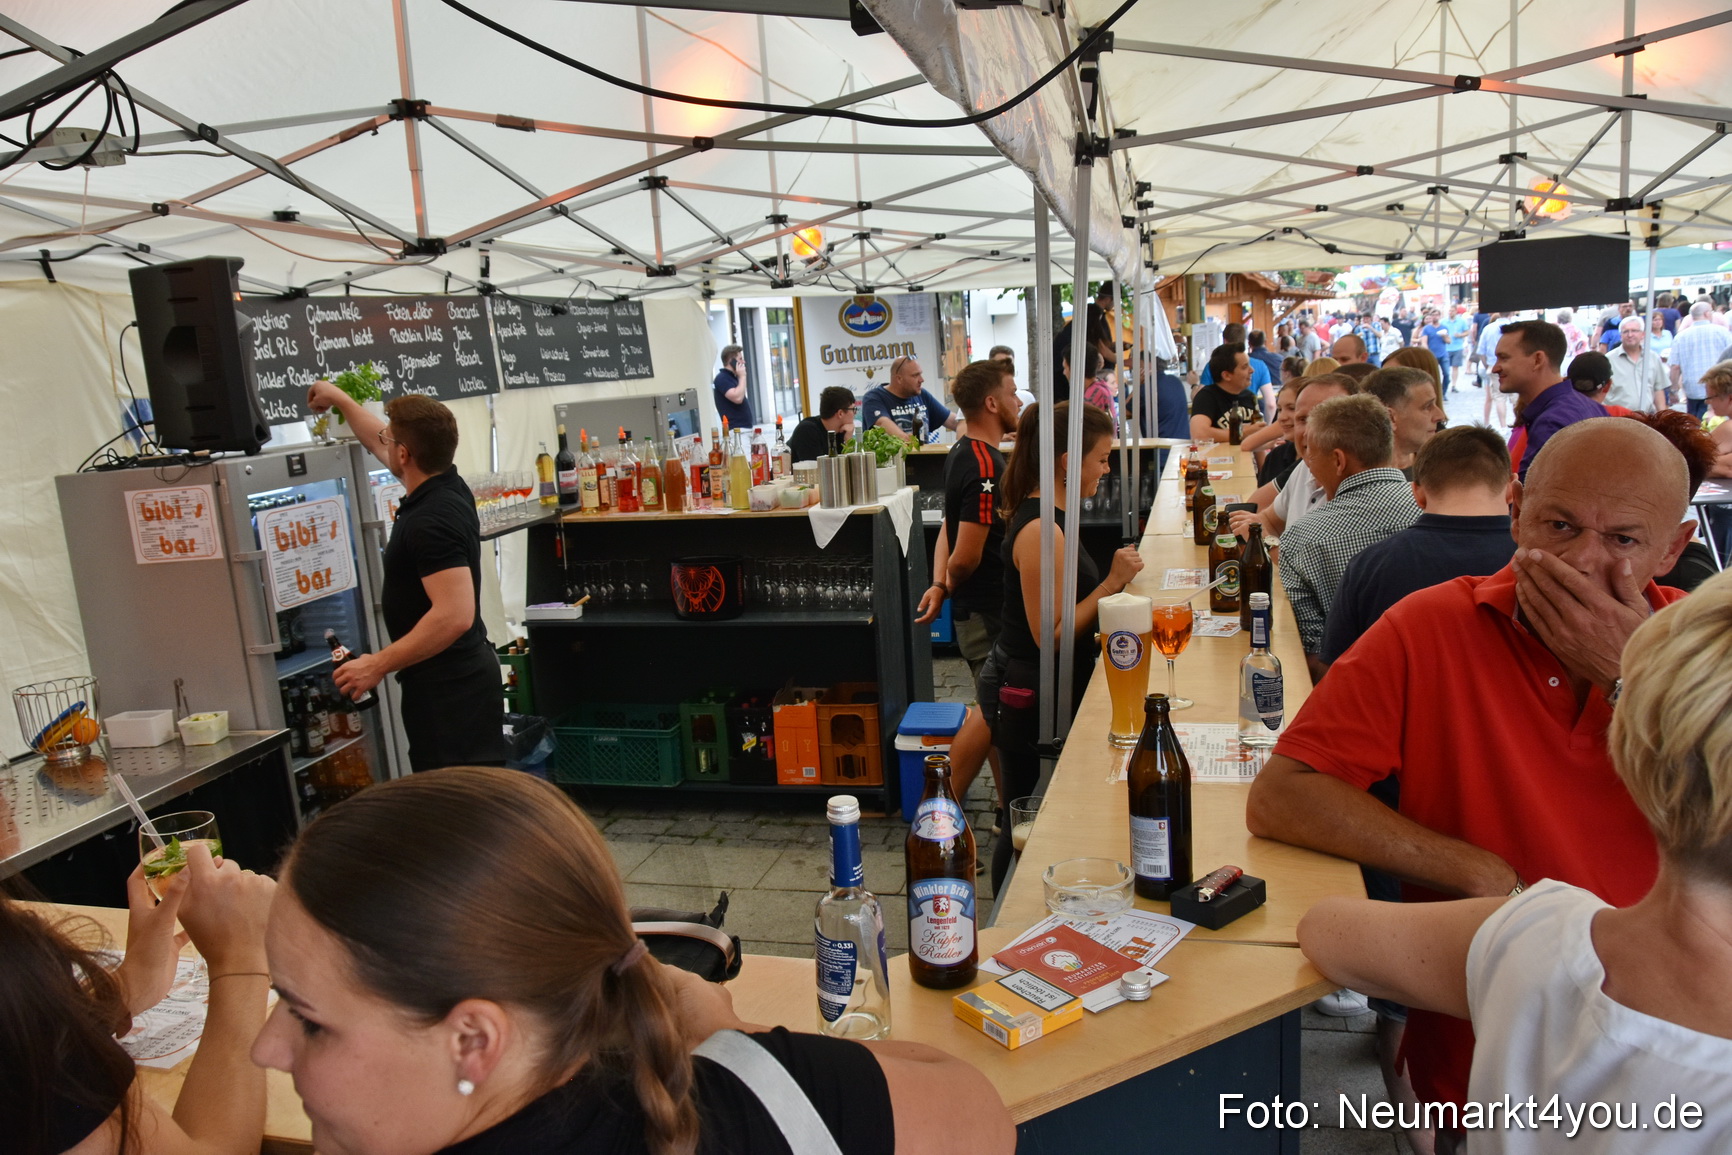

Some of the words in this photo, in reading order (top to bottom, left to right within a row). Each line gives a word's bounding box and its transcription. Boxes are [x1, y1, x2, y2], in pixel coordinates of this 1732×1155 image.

[340, 301, 362, 322] Hefe
[446, 301, 480, 320] Bacardi
[275, 337, 299, 357] Pils
[452, 325, 473, 352] Jack
[500, 349, 517, 371] Hugo
[820, 341, 917, 365] Gutmann
[287, 366, 320, 387] Radler
[542, 366, 566, 383] Prosecco
[159, 535, 195, 554] bar
[295, 567, 331, 594] bar
[913, 884, 949, 899] Winkler
[950, 884, 970, 899] Bräu
[927, 916, 957, 925] Lengenfeld
[922, 929, 963, 949] Kupfer
[1117, 936, 1157, 960] ar
[919, 944, 963, 959] Radler
[1011, 983, 1046, 1005] Rauchen
[1019, 978, 1045, 995] tödlich
[1044, 991, 1058, 1001] ist
